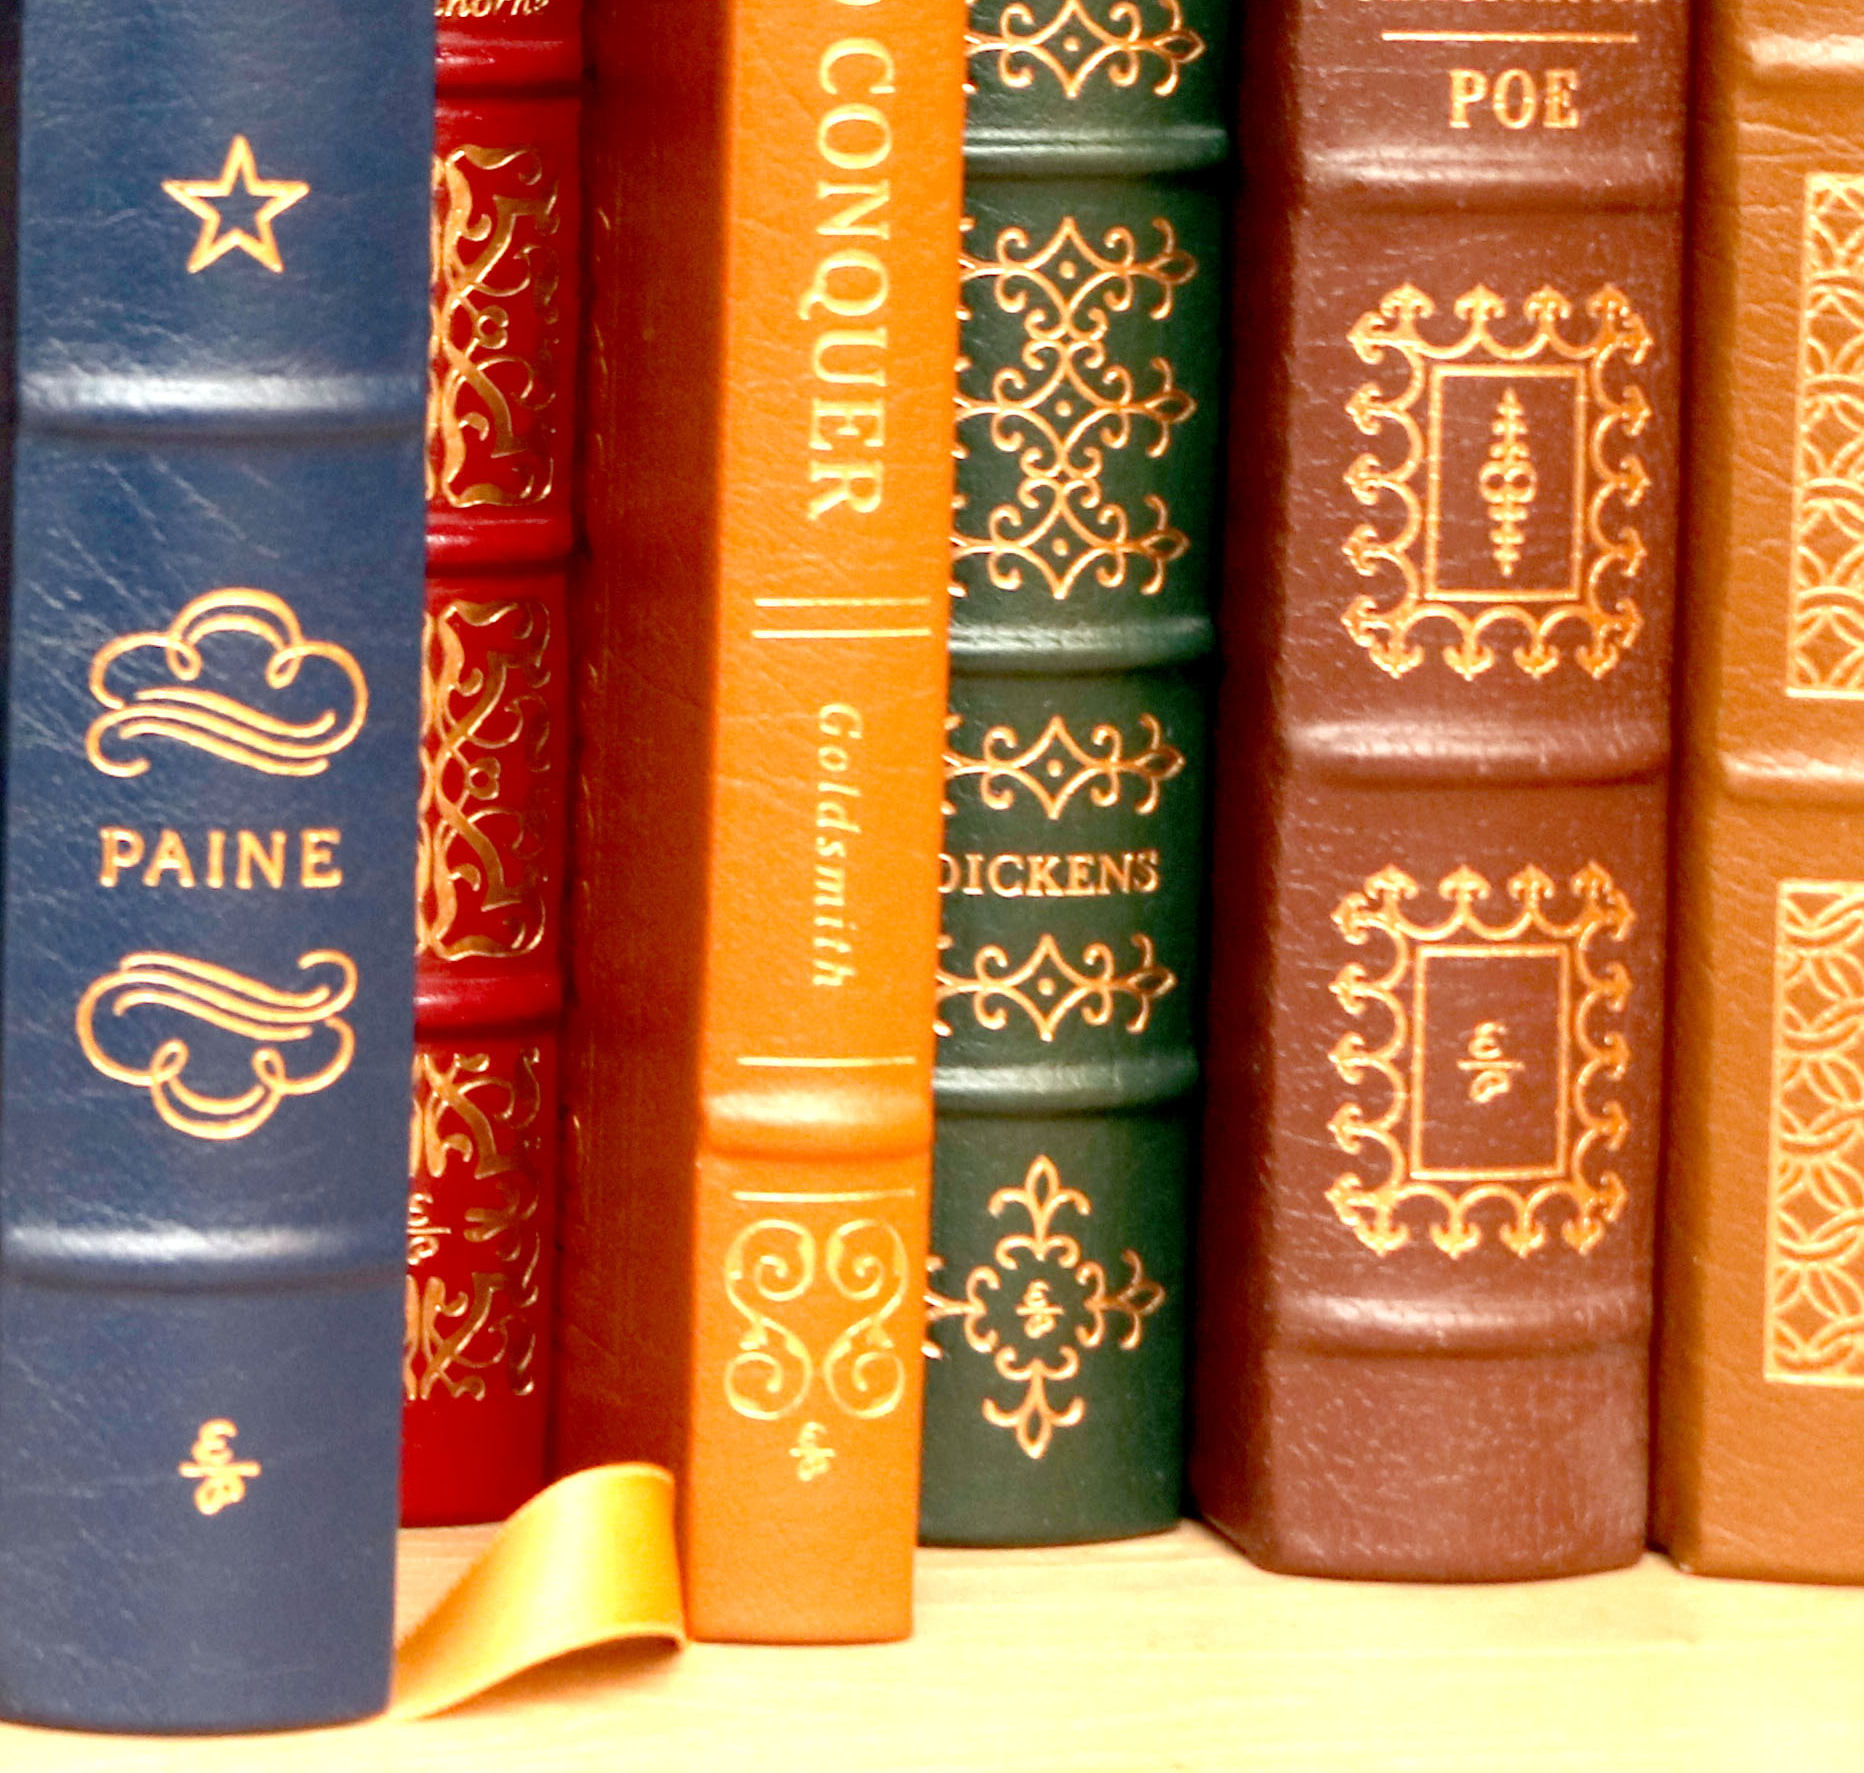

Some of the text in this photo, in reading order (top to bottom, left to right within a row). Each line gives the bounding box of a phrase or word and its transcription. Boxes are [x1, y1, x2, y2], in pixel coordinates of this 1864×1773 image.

[1448, 69, 1581, 129] POE
[796, 38, 898, 521] CONQUER
[97, 826, 343, 890] PAINE
[811, 701, 864, 990] Goldsmith
